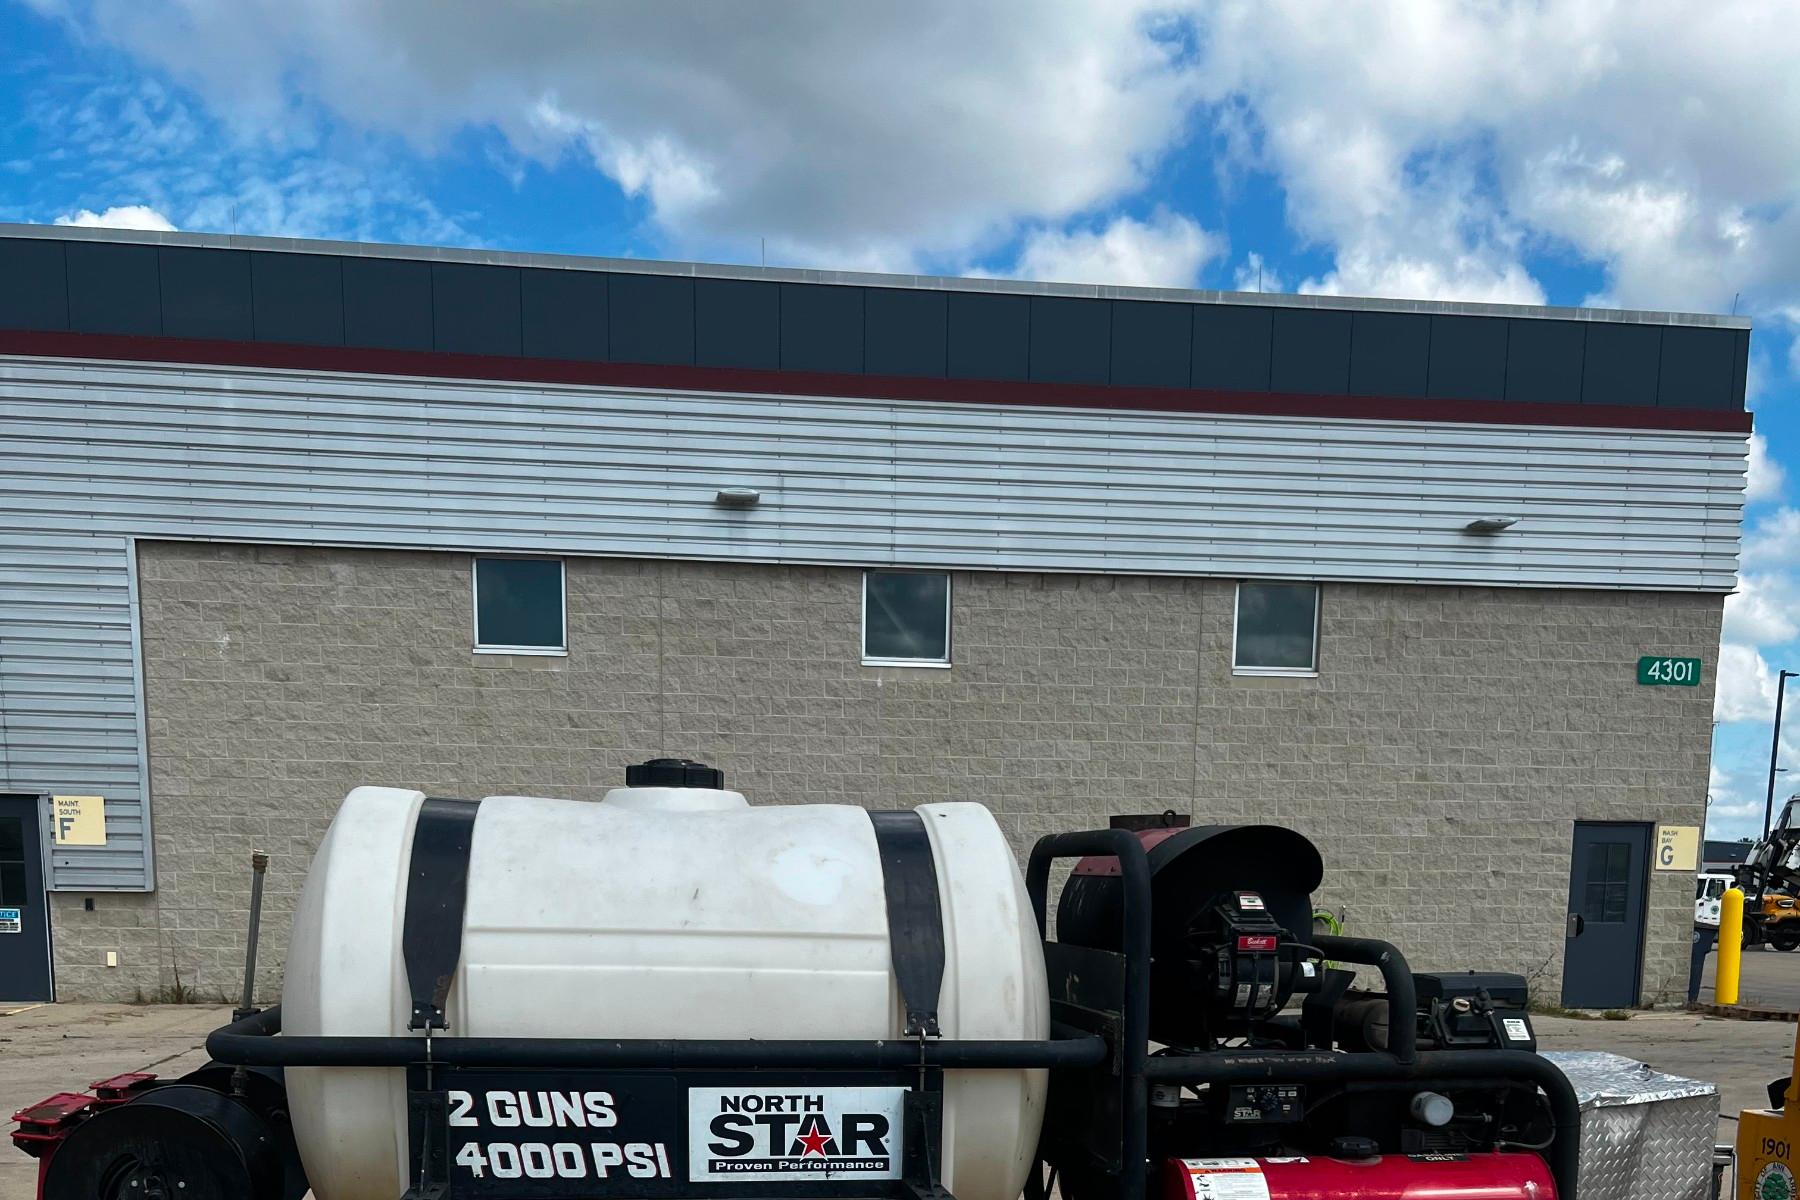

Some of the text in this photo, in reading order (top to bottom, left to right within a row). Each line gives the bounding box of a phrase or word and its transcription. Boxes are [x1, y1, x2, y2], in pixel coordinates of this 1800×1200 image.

[1647, 659, 1693, 682] 4301
[59, 817, 75, 840] F
[1660, 845, 1674, 865] G
[448, 1090, 618, 1128] 2 GUNS
[720, 1095, 824, 1112] NORTH
[707, 1113, 890, 1157] STAR
[455, 1142, 672, 1178] 4000 PSI
[1761, 1137, 1791, 1160] 1901
[715, 1159, 885, 1171] Proven Performance
